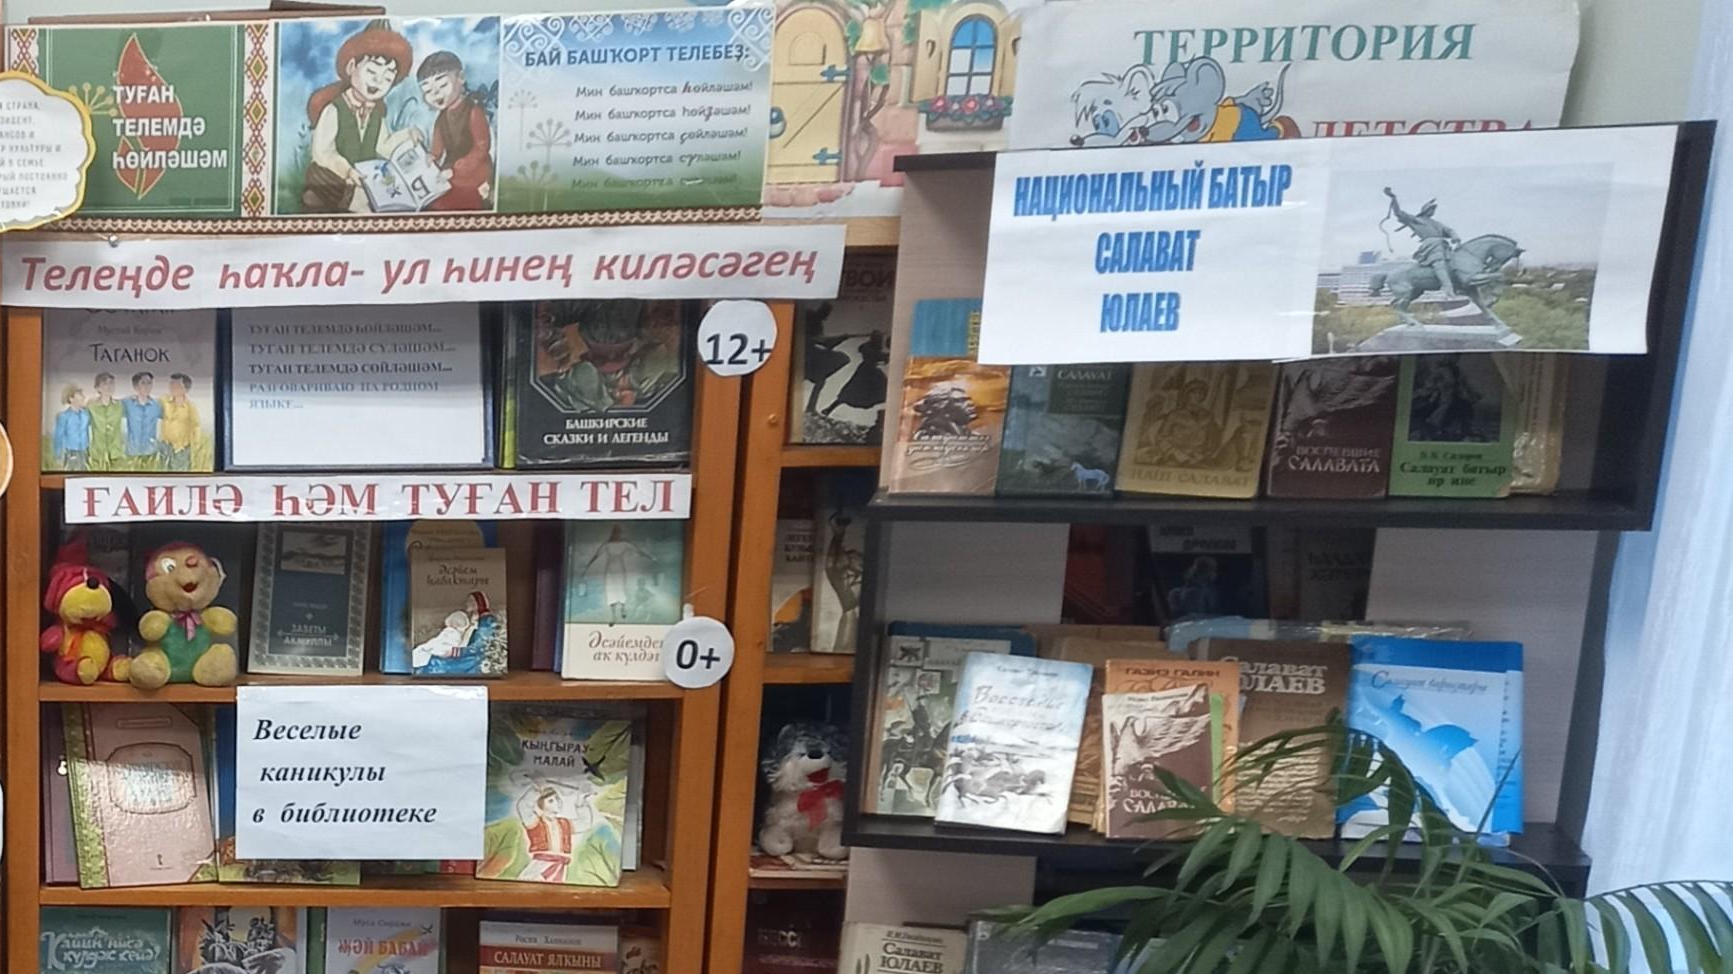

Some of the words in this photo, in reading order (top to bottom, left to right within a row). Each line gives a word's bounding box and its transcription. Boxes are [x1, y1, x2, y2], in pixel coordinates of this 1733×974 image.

[1134, 23, 1476, 66] ТЕРРИТОРИЯ
[525, 50, 561, 67] БАЙ
[567, 48, 661, 66] БАШҠОРТ
[113, 85, 174, 104] ТУҒАН
[576, 86, 603, 98] Мин
[575, 109, 602, 121] Мин
[113, 118, 206, 138] ТЕЛЕМДӘ
[574, 132, 600, 144] Мин
[573, 155, 599, 167] Мин
[1014, 161, 1204, 220] НАЦИОНАЛЬНЫЙ
[1209, 163, 1292, 209] БАТЫР
[1094, 230, 1200, 275] САЛАВАТ
[21, 255, 195, 298] Телеңде
[382, 257, 431, 293] ул
[442, 252, 572, 288] һинең
[594, 248, 818, 285] киләсәгең
[1099, 291, 1181, 334] ЮЛАЕВ
[705, 332, 773, 366] 12+
[565, 417, 649, 430] БАШКИРСКИЕ
[543, 433, 594, 445] СКАЗКИ
[597, 433, 608, 444] И
[611, 432, 669, 444] ЛЕГЕНДЫ
[83, 483, 244, 518] ҒАИЛӘ
[275, 482, 378, 517] ҺӘМ
[401, 481, 561, 516] ТУҒАН
[579, 479, 675, 514] ТЕЛ
[675, 640, 722, 670] 0+
[1125, 666, 1171, 678] ГАЗИЗ
[1173, 668, 1220, 678] ГАЛИН
[253, 719, 362, 743] Веселые
[260, 761, 386, 785] каникулы
[252, 805, 265, 824] в
[279, 800, 437, 826] библиотеке
[493, 951, 544, 965] САЛАУАТ
[882, 942, 942, 961] Салават
[880, 956, 944, 974] ЮЛАЕВ
